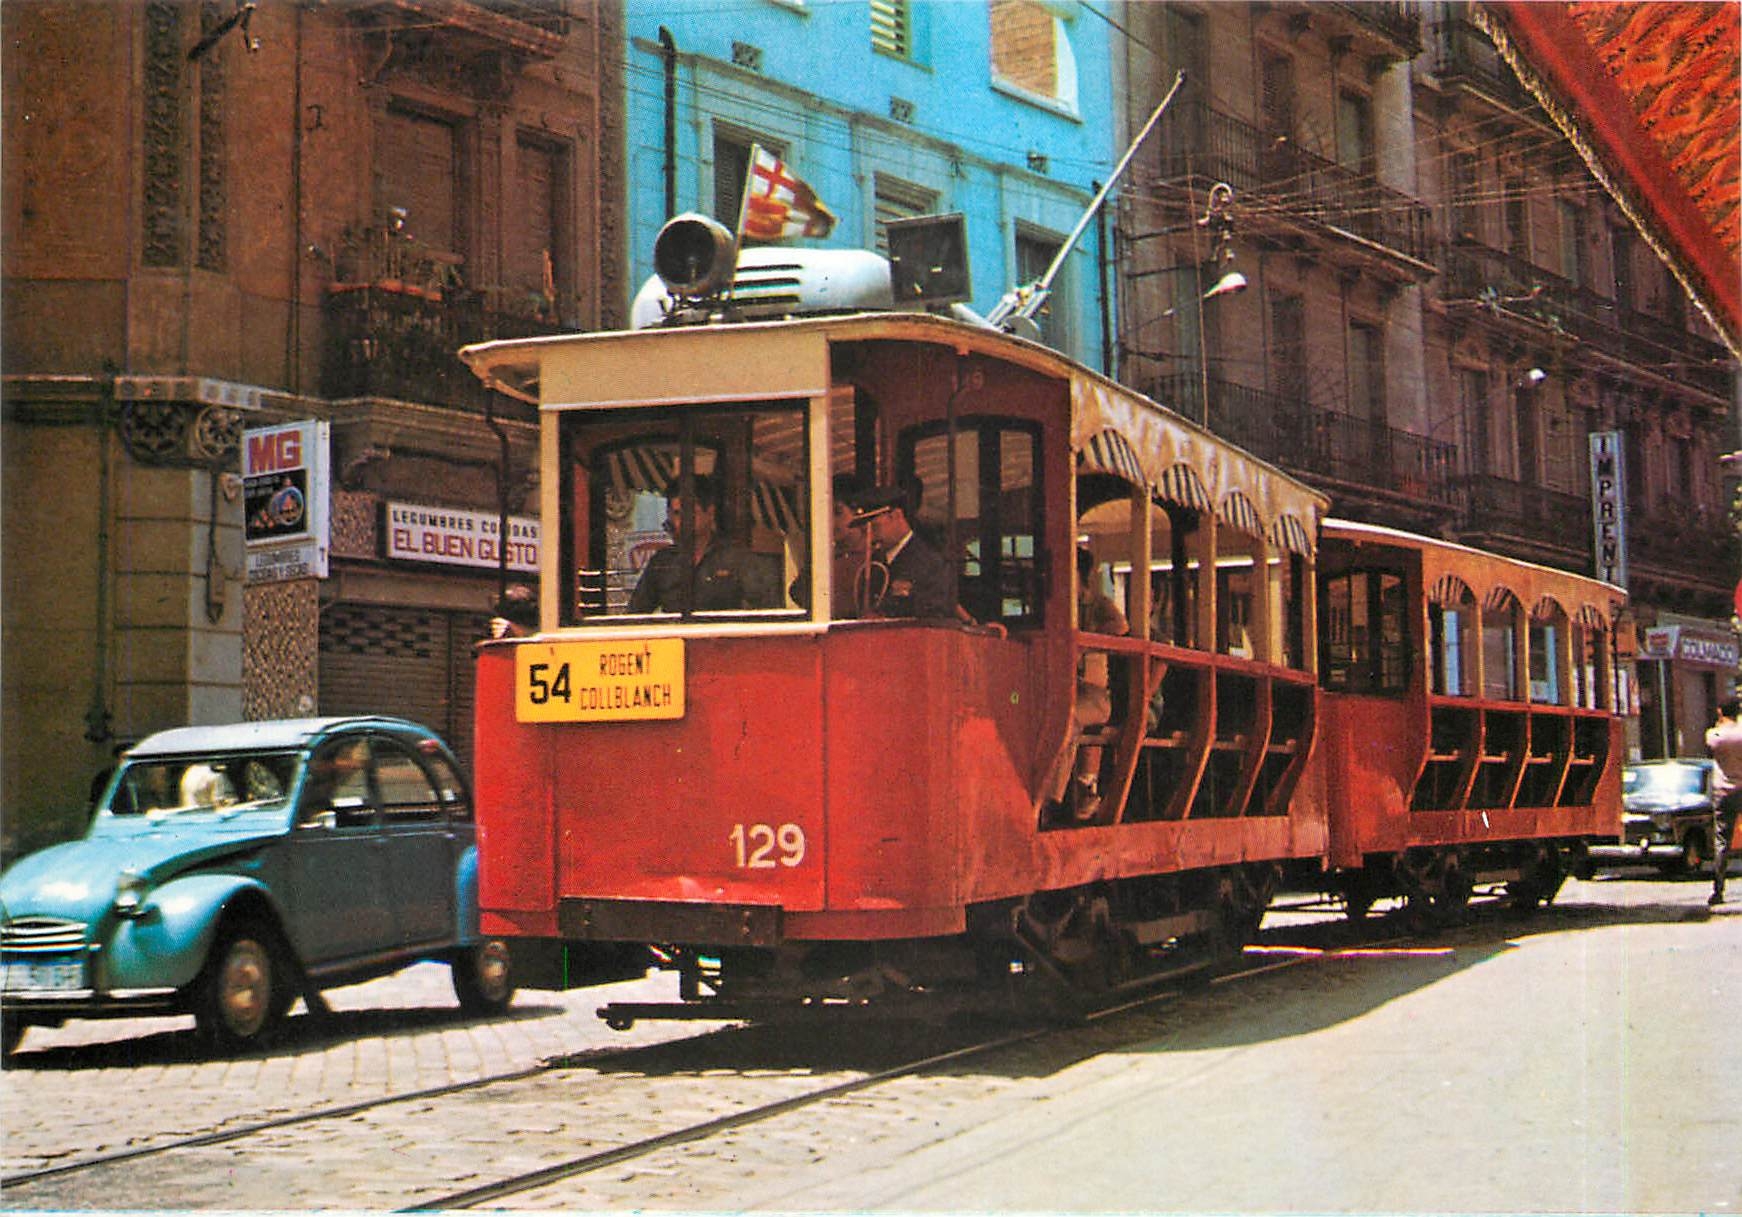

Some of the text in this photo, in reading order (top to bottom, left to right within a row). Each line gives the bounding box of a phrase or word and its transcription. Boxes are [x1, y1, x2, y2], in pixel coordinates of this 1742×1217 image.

[249, 431, 301, 474] MG
[393, 510, 537, 538] LEGUMBRES COIDAS
[394, 528, 537, 565] EL BUEN GUSTO
[600, 651, 652, 676] ROGENT
[529, 662, 571, 705] 54
[580, 684, 671, 711] COLLBLANCH
[728, 823, 806, 869] 129
